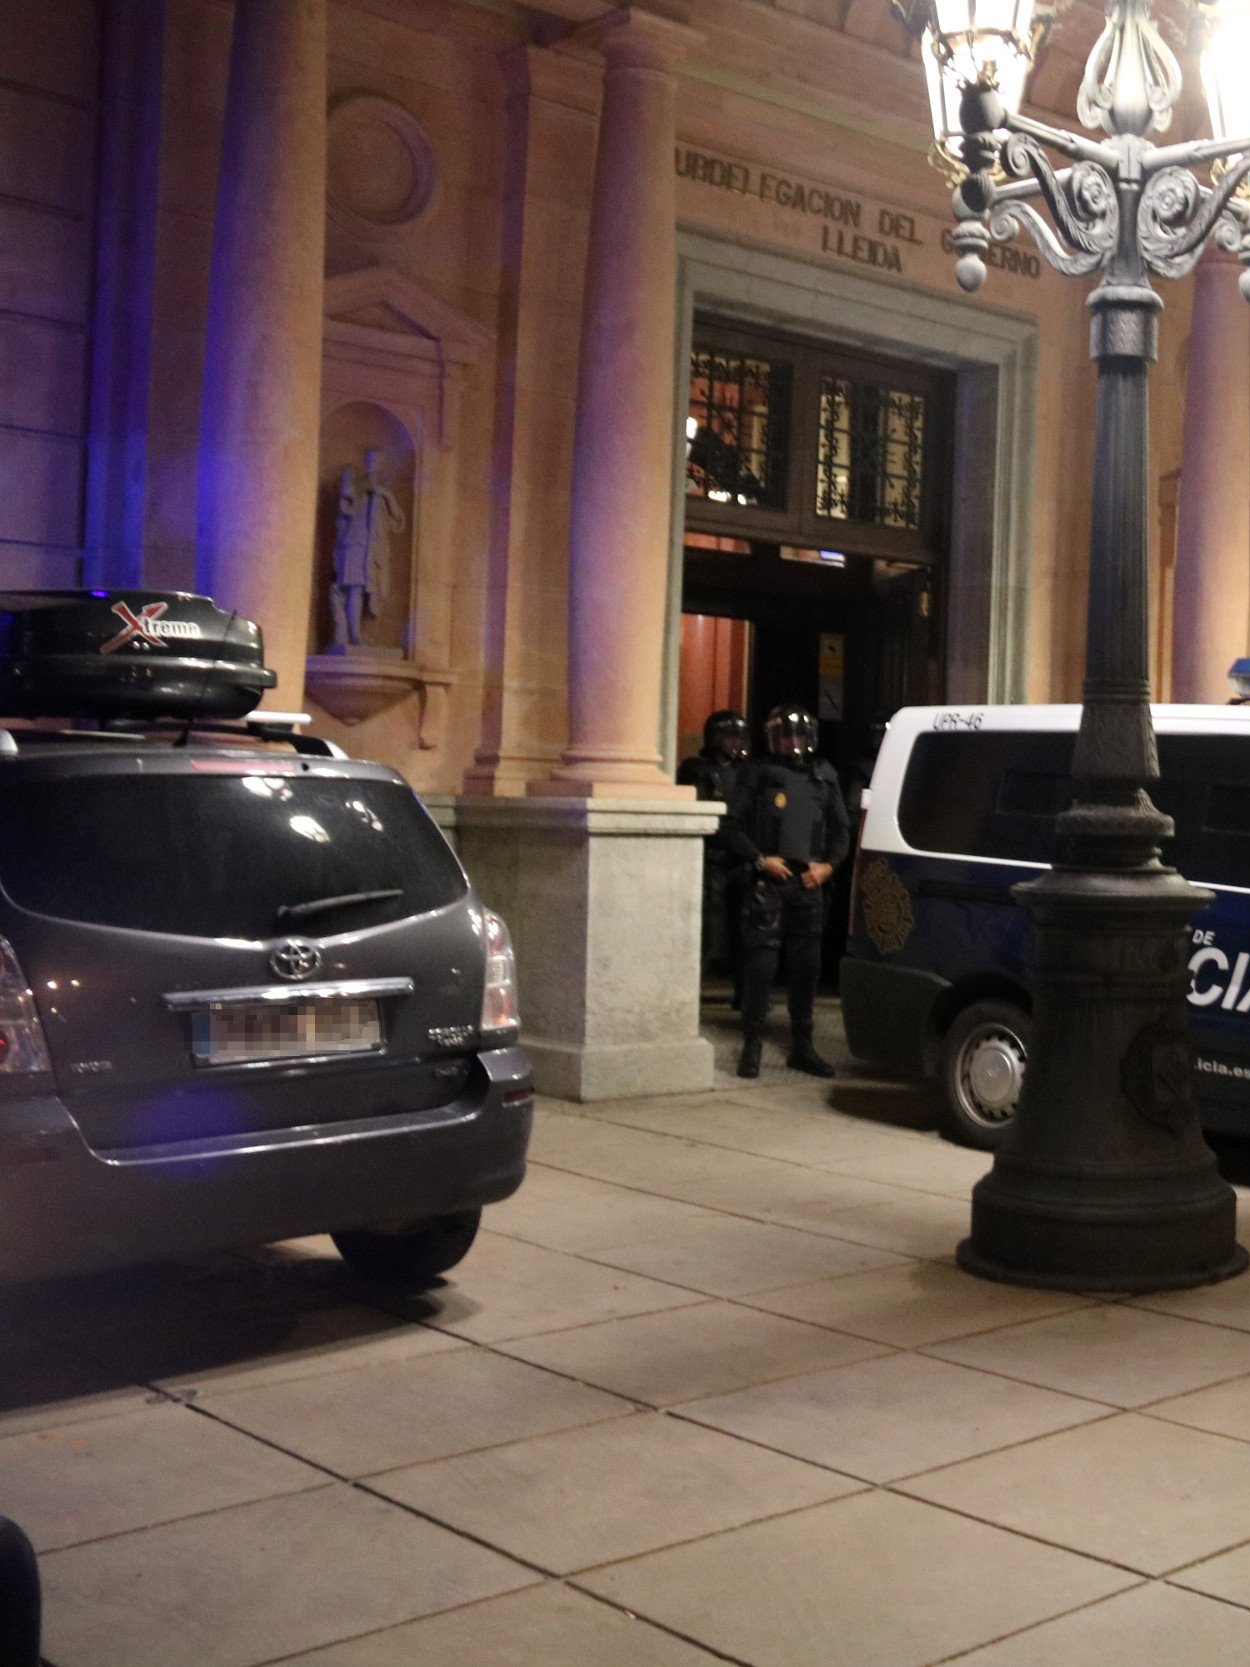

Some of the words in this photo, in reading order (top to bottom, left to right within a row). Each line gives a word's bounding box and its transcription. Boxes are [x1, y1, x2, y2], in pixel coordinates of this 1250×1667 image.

[675, 146, 862, 228] UBDELEGACION
[878, 210, 923, 247] DEL
[941, 228, 1040, 279] GERNO
[822, 226, 904, 273] LLEIDA
[1192, 929, 1216, 945] DE
